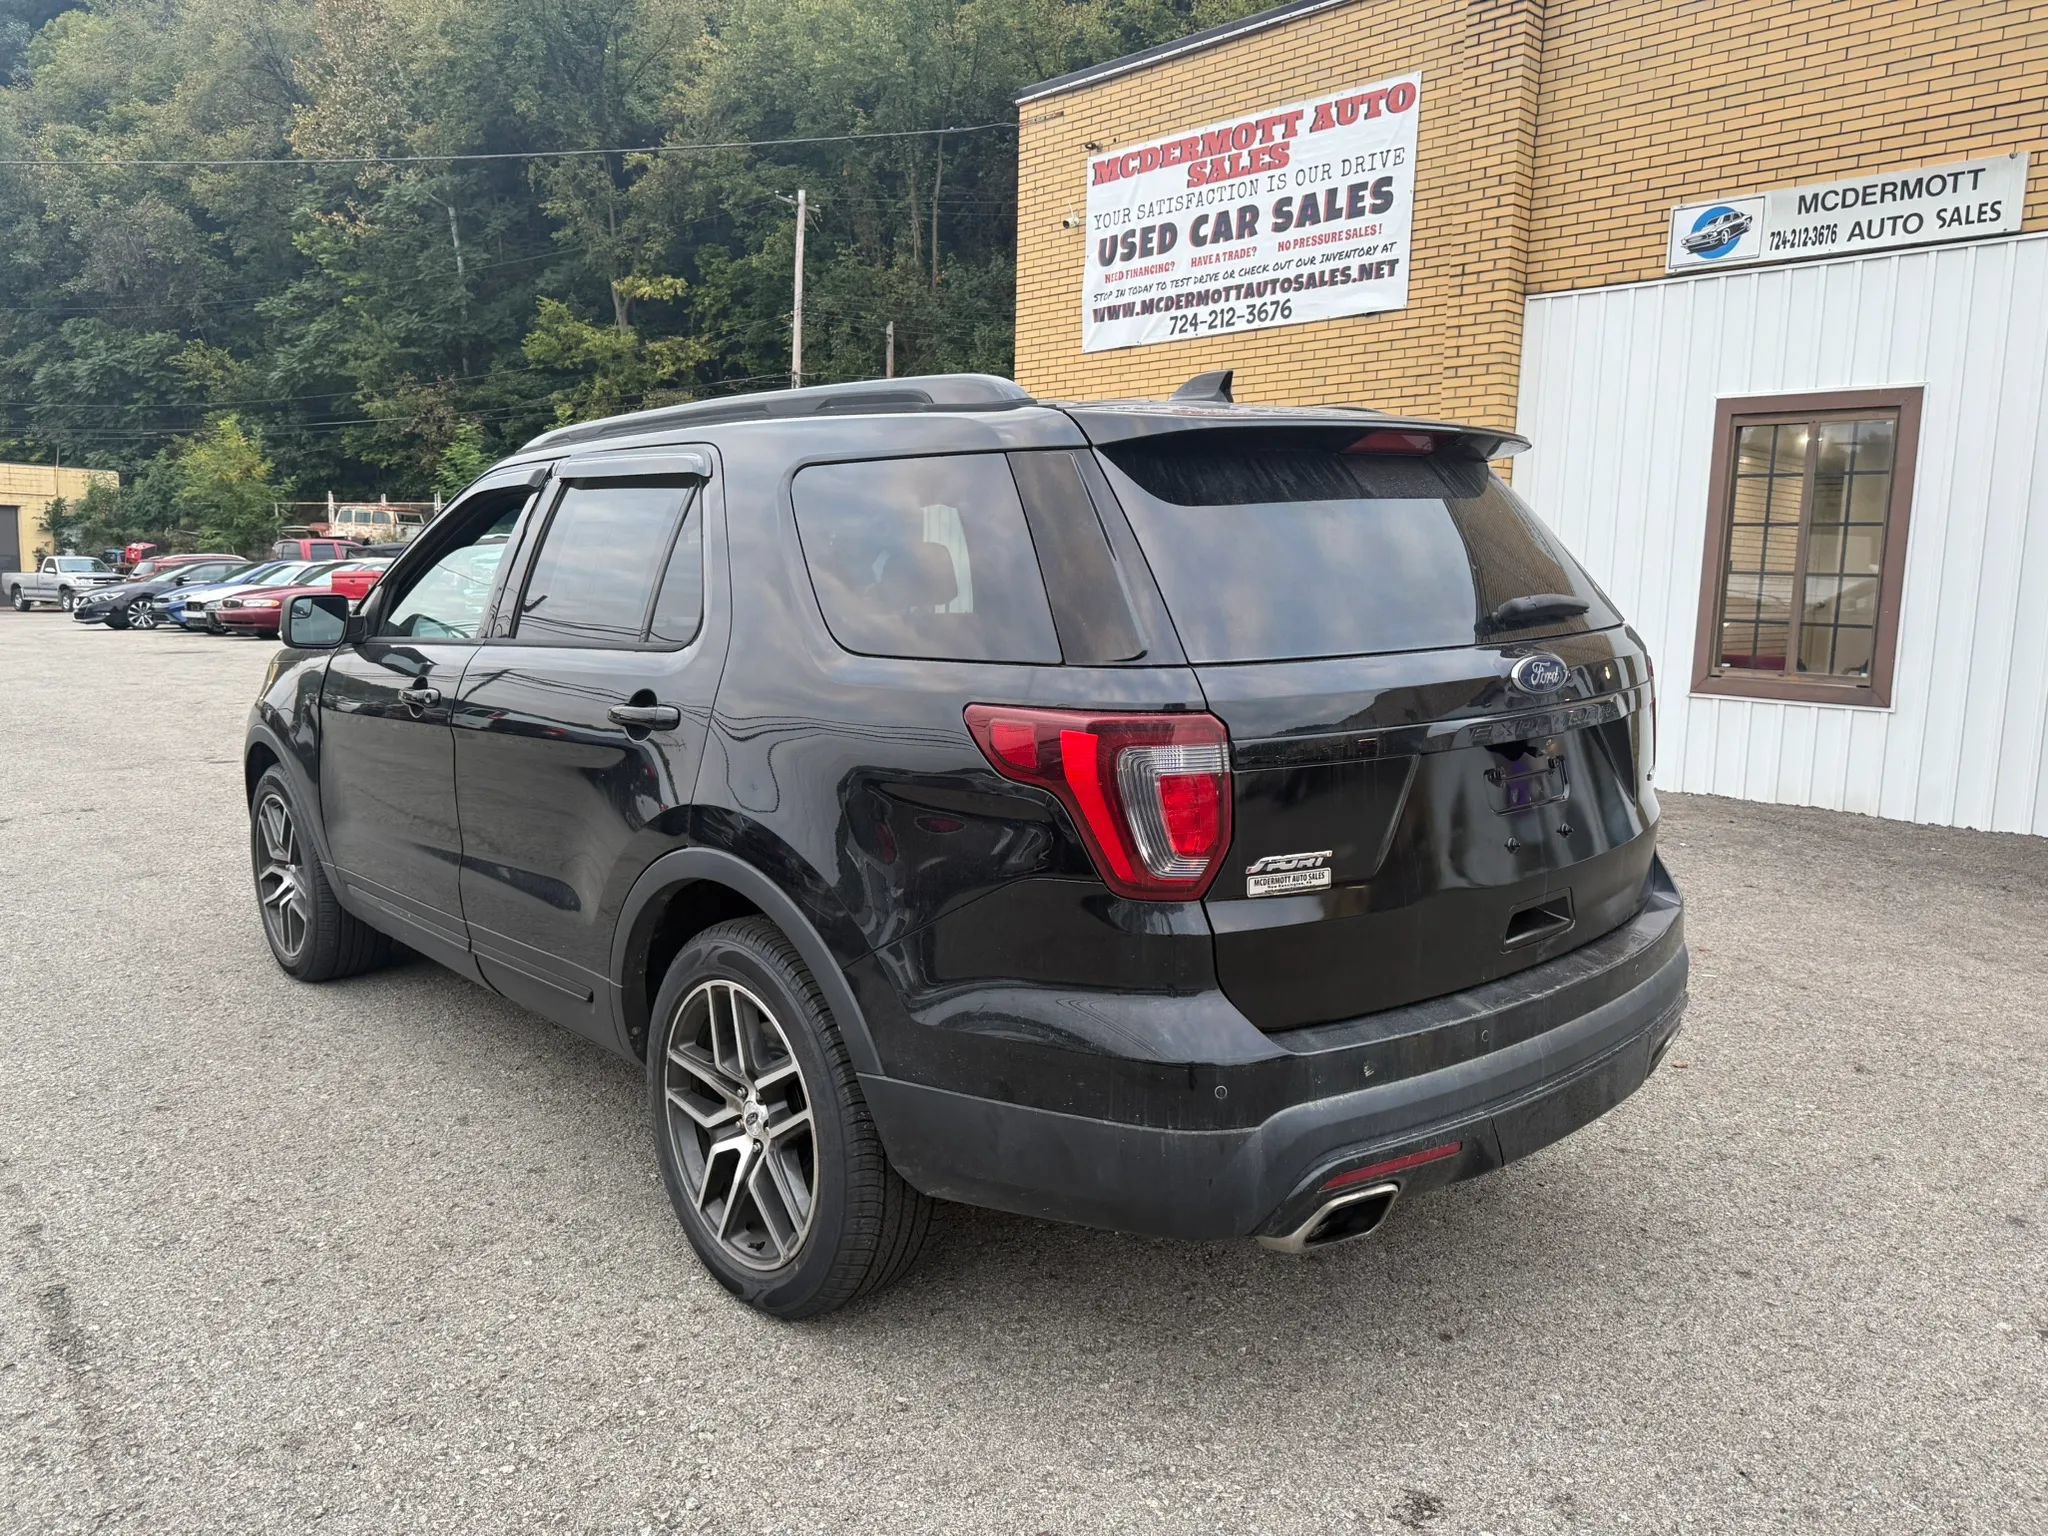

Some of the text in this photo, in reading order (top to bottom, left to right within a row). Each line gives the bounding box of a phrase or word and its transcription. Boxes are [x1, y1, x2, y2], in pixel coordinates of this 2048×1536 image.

[1092, 82, 1417, 186] MCDERMOTT AUTO
[1187, 141, 1290, 188] SALES
[1094, 147, 1405, 230] YOUR SATISFACTION IS OUR DRIVE
[1797, 168, 1986, 215] MCDERMOTT
[1098, 176, 1394, 267] USED CAR SALES
[1769, 223, 1838, 251] 724-212-3676
[1846, 200, 2002, 242] AUTO SALES
[1191, 246, 1257, 267] HAVE A TRADE?
[1277, 240, 1291, 252] NO
[1293, 231, 1343, 249] PRESSURE
[1092, 258, 1399, 323] WWW.MCDERMOTTAUTOSALES.NET
[1093, 241, 1397, 303] STOP IN TODAY TO TEST DRIVE OR CHECK OUT OUR INVENTORY AT
[1104, 261, 1175, 284] NEED FINANCING?
[1169, 298, 1292, 336] 724-212-3676
[1531, 661, 1560, 685] Ford
[1246, 850, 1333, 874] SPORT
[1254, 875, 1291, 887] MCDERMOTT
[1291, 873, 1308, 883] AUTO
[1308, 871, 1325, 881] SALES
